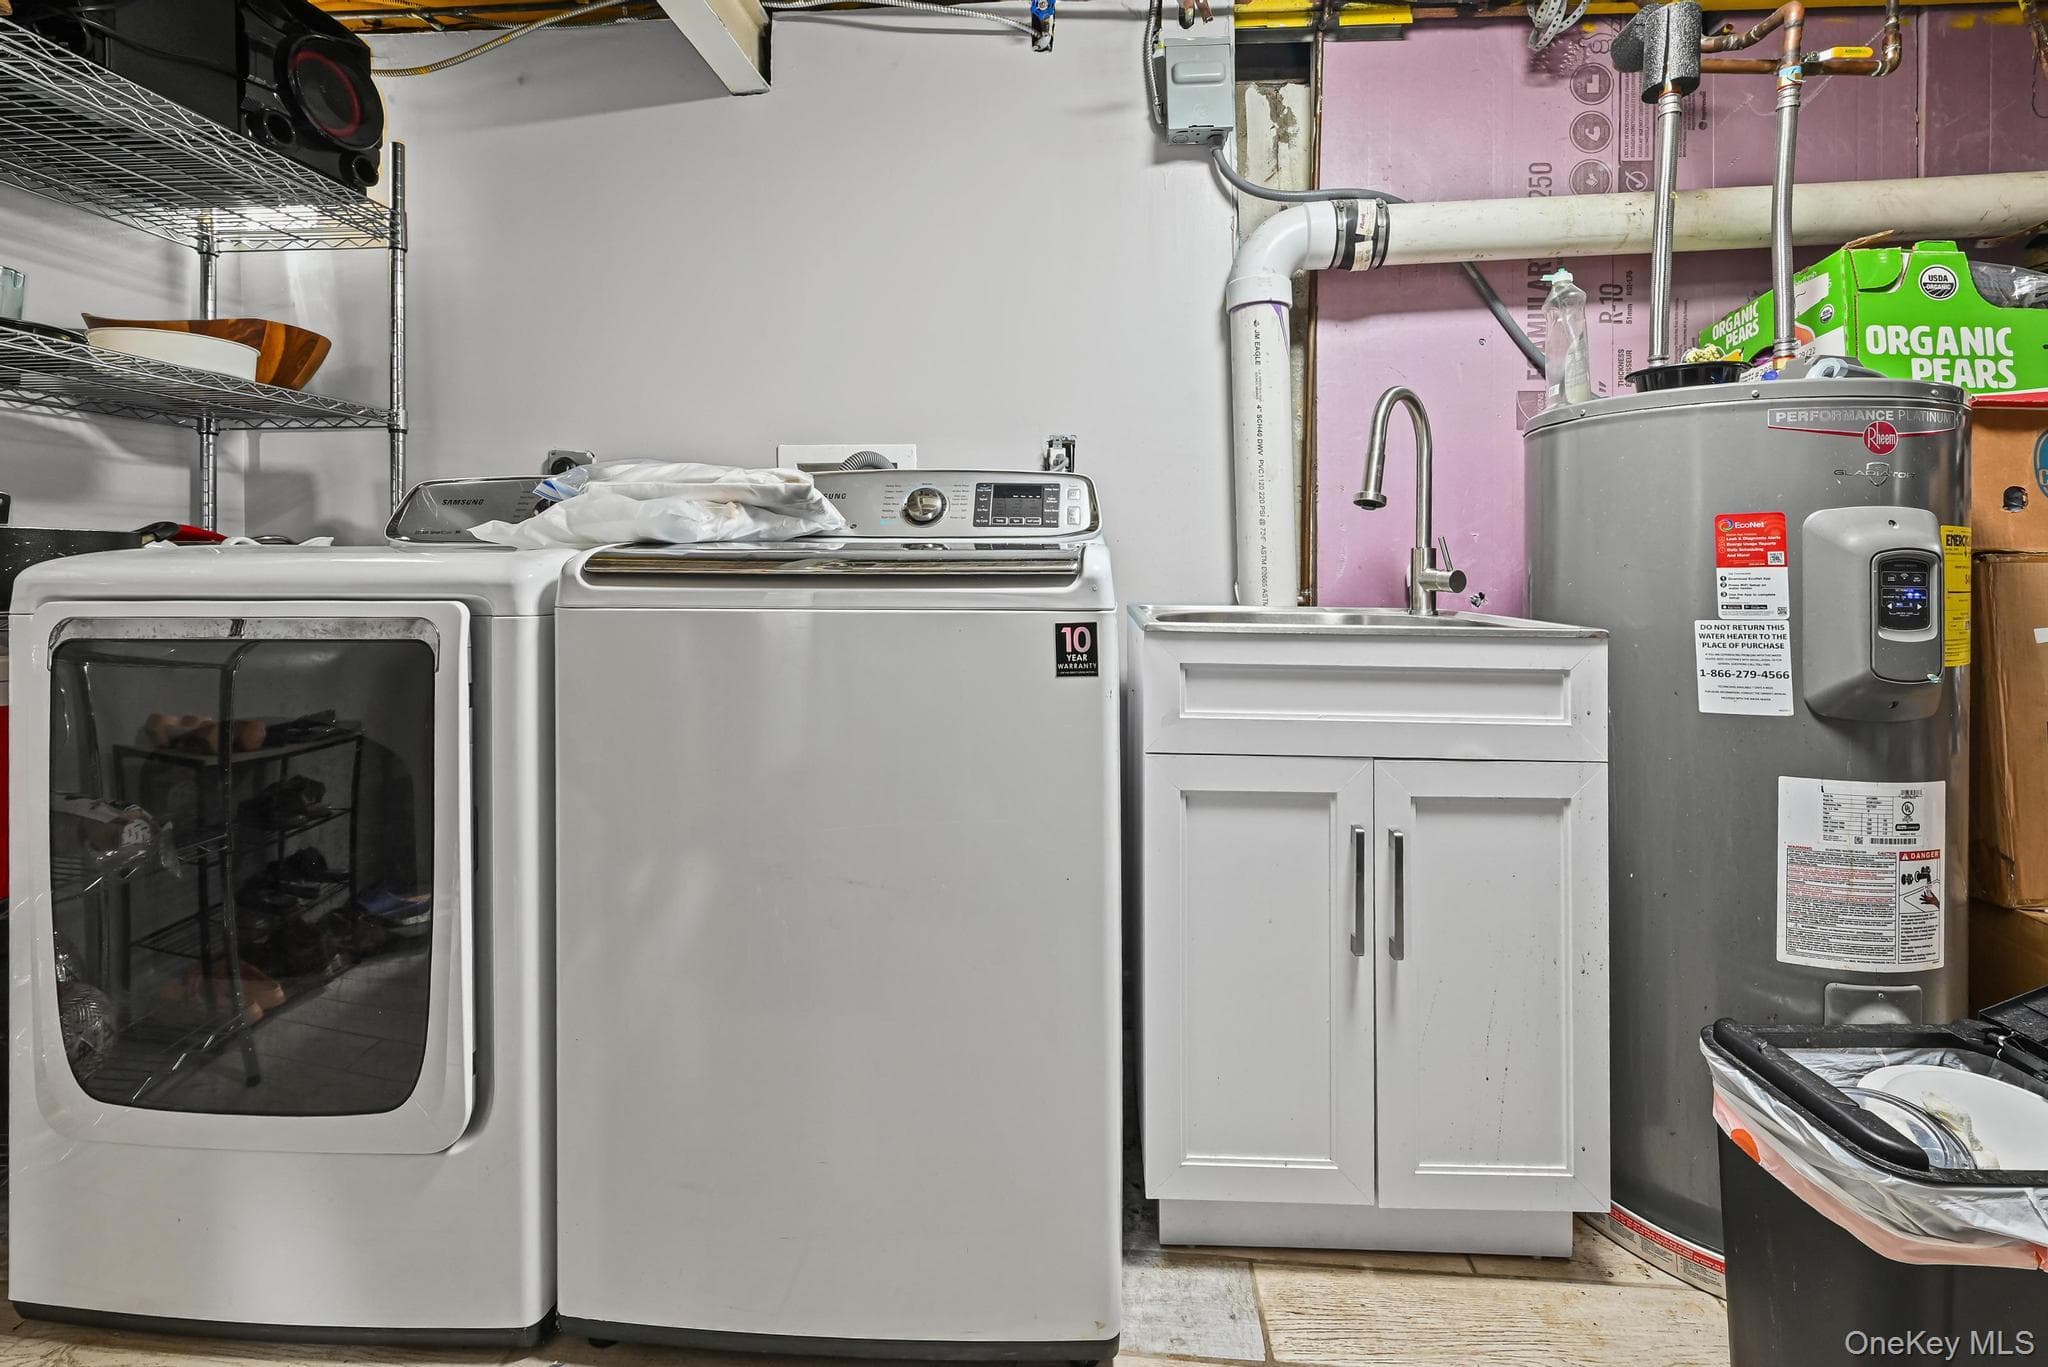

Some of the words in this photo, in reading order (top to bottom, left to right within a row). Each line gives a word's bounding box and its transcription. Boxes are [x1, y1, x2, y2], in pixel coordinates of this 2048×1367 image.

[1928, 274, 1949, 282] USDA
[1599, 283, 1624, 324] R-10
[1527, 260, 1552, 381] FAMULAR
[1712, 301, 1759, 341] ORGANIC
[1254, 330, 1260, 340] JM
[1726, 318, 1760, 350] PEARS
[1865, 325, 2014, 357] ORGANIC
[1617, 348, 1625, 388] THICKNESS
[1911, 357, 2017, 389] PEARS
[1775, 410, 1895, 423] PERFORMANCE
[1898, 410, 1950, 424] PLATINUM
[1867, 421, 1897, 450] Rheem
[1833, 469, 1918, 480] GLADIATOR
[1735, 521, 1765, 529] EcoNet
[1061, 626, 1091, 653] 10
[1741, 642, 1785, 650] PURCHASE
[1066, 654, 1088, 662] YEAR
[1057, 662, 1097, 670] WARRANTY
[1700, 669, 1790, 680] 1-866-279-4566
[1910, 851, 1939, 860] DANGER
